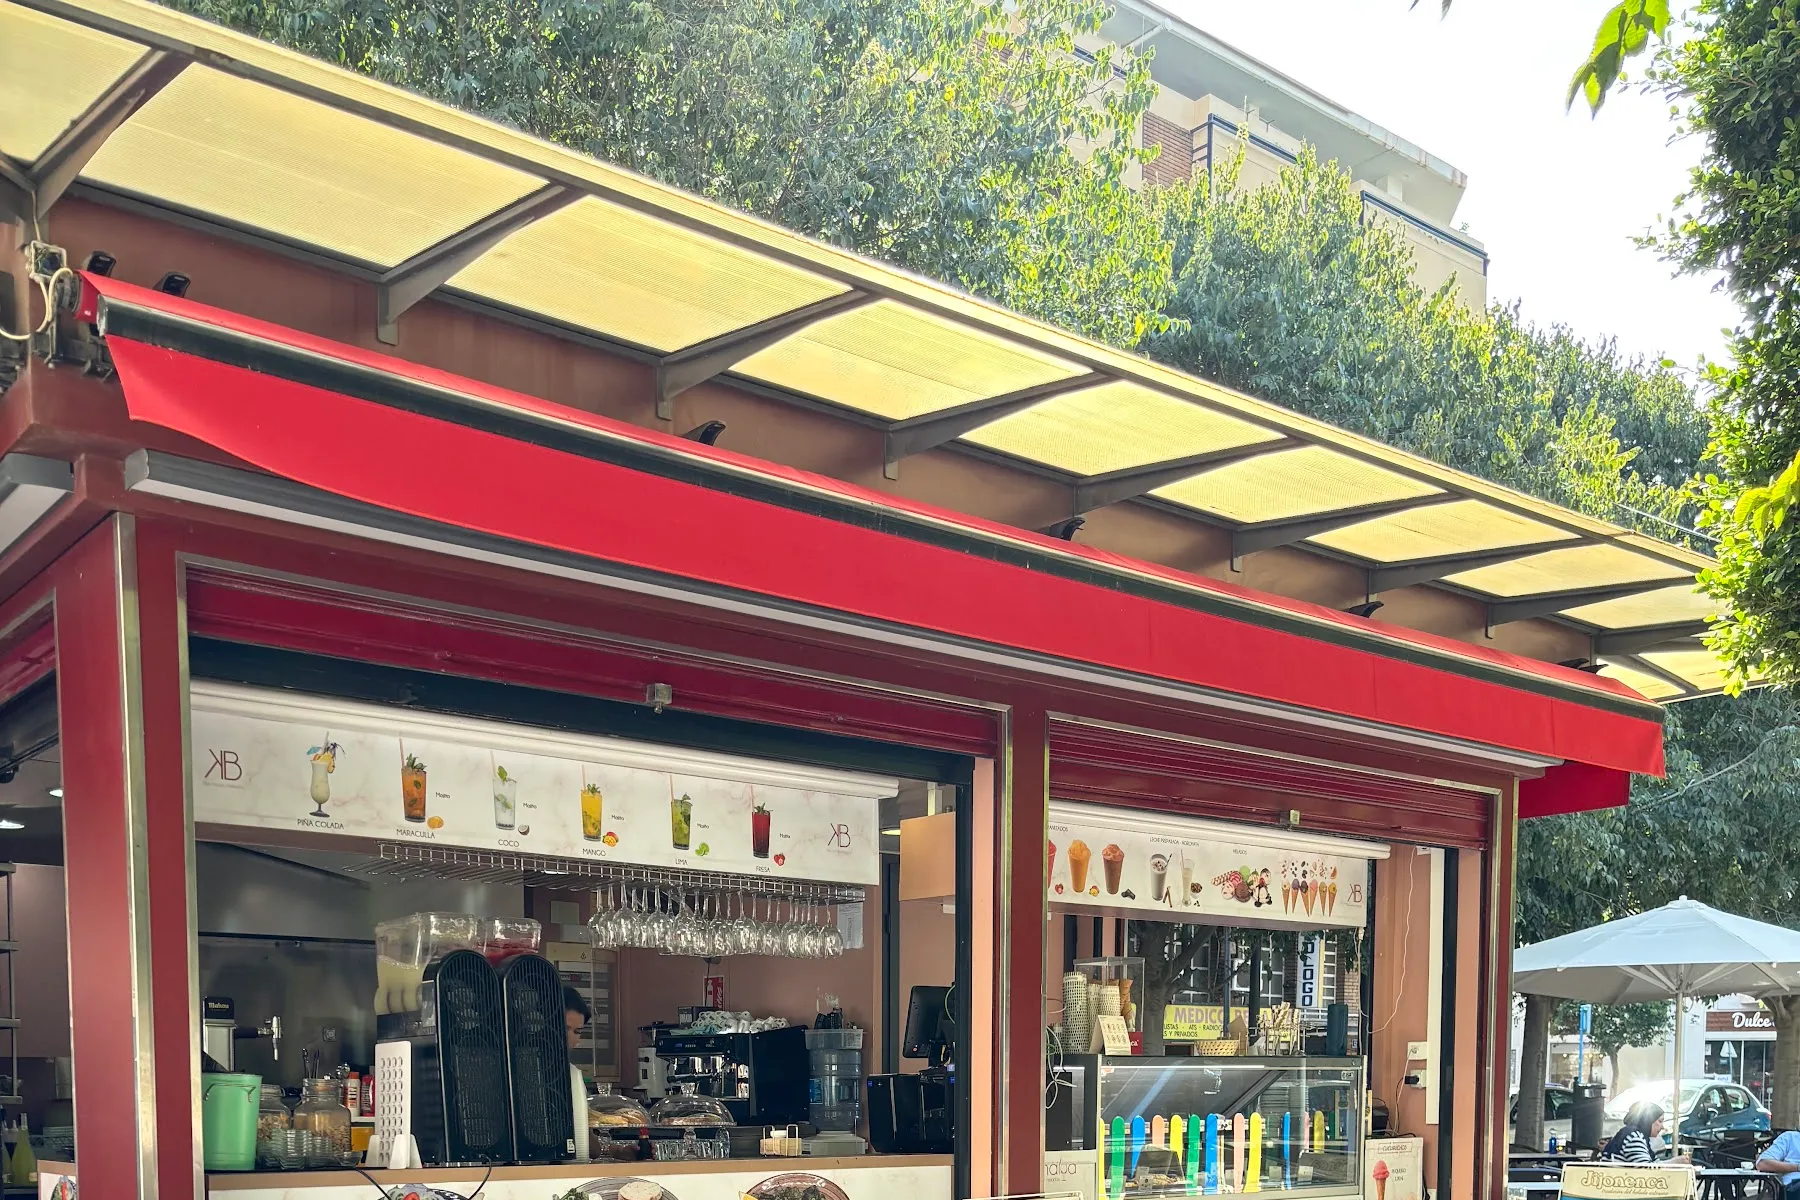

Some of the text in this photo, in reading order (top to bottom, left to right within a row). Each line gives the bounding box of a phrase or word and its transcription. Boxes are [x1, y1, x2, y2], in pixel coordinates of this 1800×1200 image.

[297, 817, 345, 830] PIÑA COLADA
[396, 828, 436, 839] MARACULLA
[498, 838, 520, 848] COCO
[582, 848, 607, 857] MANGO
[675, 858, 688, 866] LIMA
[755, 865, 771, 873] FRESA
[1731, 1011, 1772, 1028] Dulce
[1580, 1170, 1669, 1190] Jijonenca
